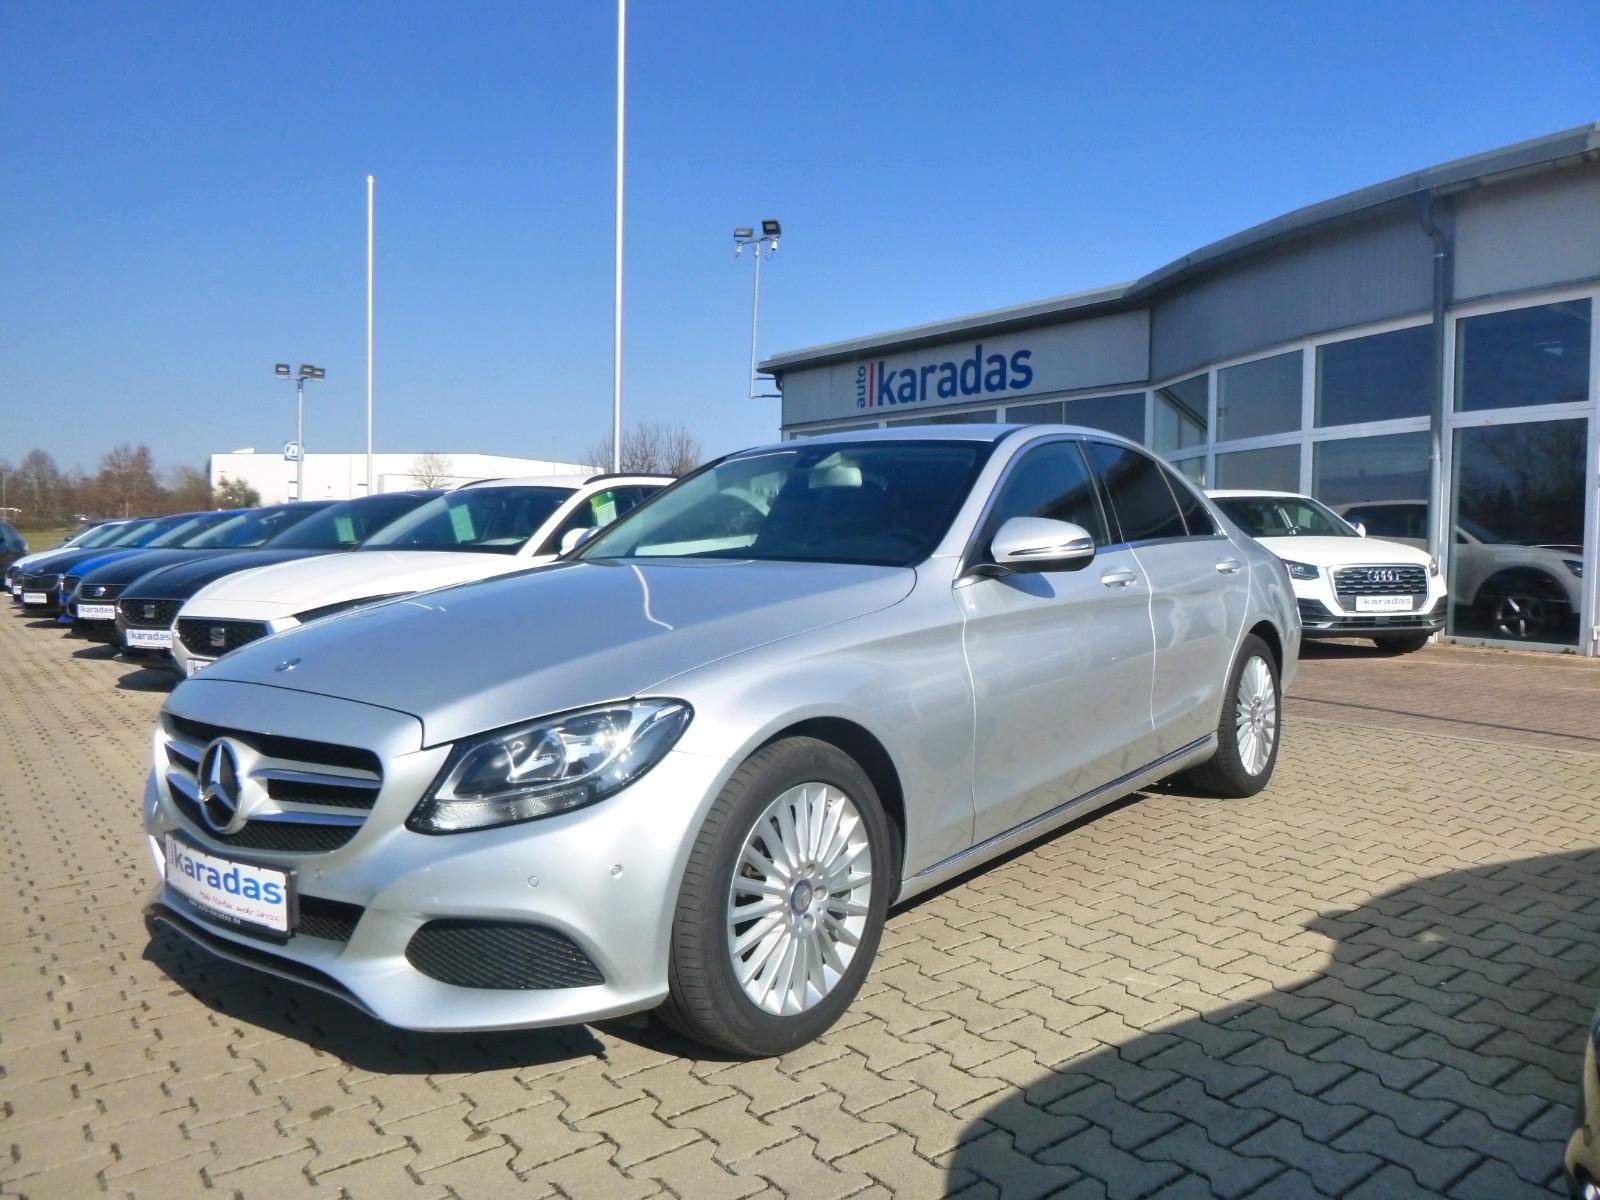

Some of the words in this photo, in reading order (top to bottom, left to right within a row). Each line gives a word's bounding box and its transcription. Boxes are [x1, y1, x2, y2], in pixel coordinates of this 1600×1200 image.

[856, 365, 867, 409] auto
[876, 344, 1034, 407] karadas
[82, 605, 114, 614] karadas
[1363, 597, 1411, 605] karadas
[130, 631, 171, 641] karadas
[174, 842, 283, 905] karadas
